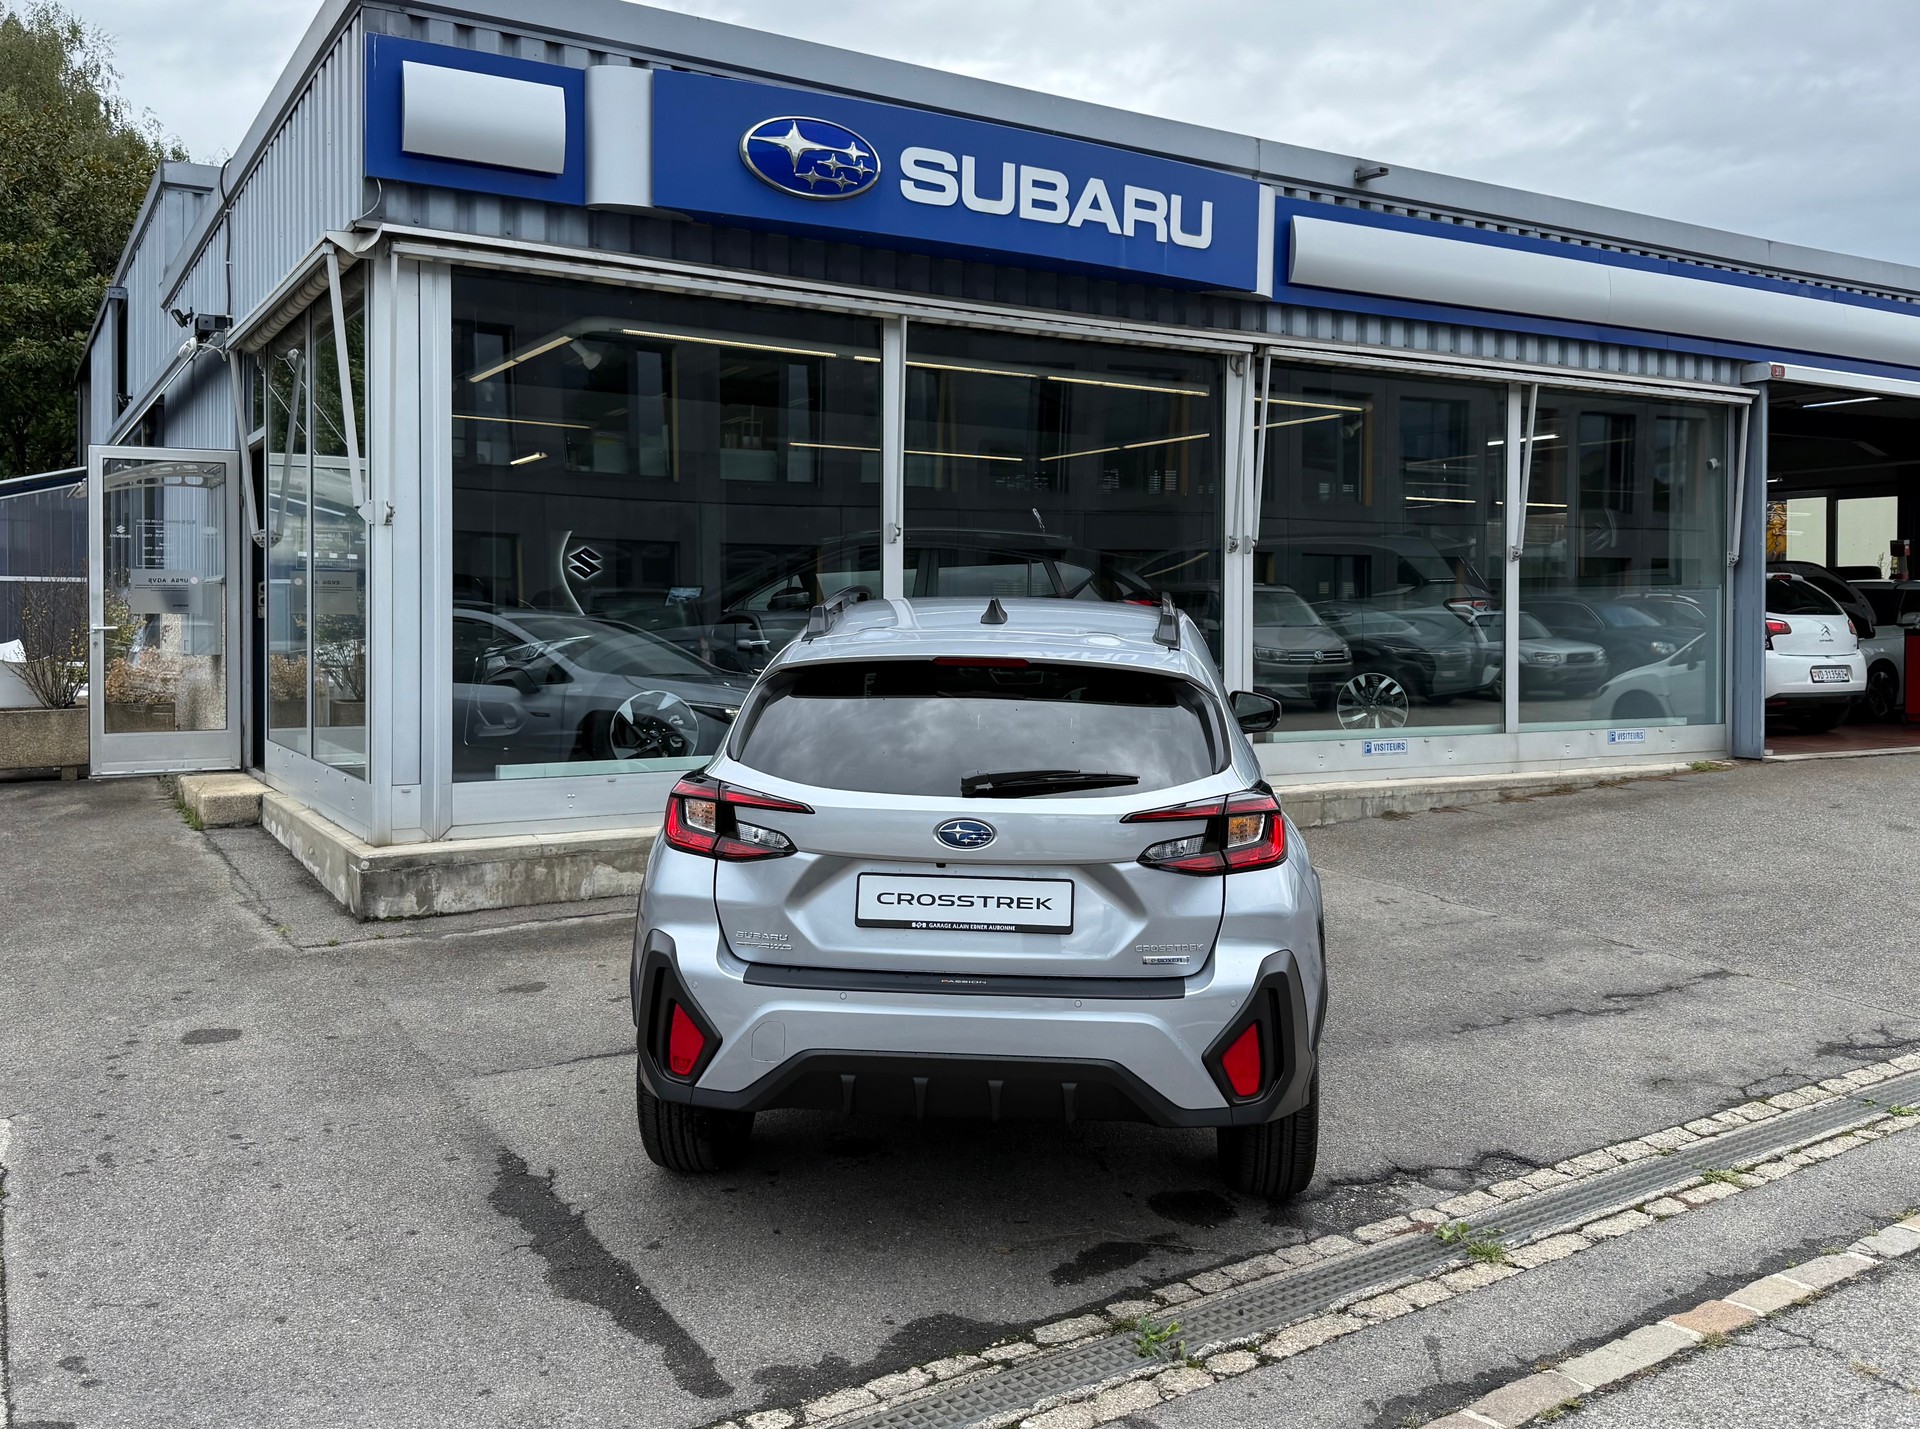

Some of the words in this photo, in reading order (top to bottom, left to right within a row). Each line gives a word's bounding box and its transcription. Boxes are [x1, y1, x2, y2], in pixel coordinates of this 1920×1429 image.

[900, 146, 1213, 249] SUBARU
[1617, 731, 1644, 741] VISITEURS
[1373, 742, 1406, 751] VISITEURS
[876, 892, 1053, 911] CROSSTREK
[736, 930, 788, 941] SUBARU
[1135, 943, 1204, 953] CROSSTREK
